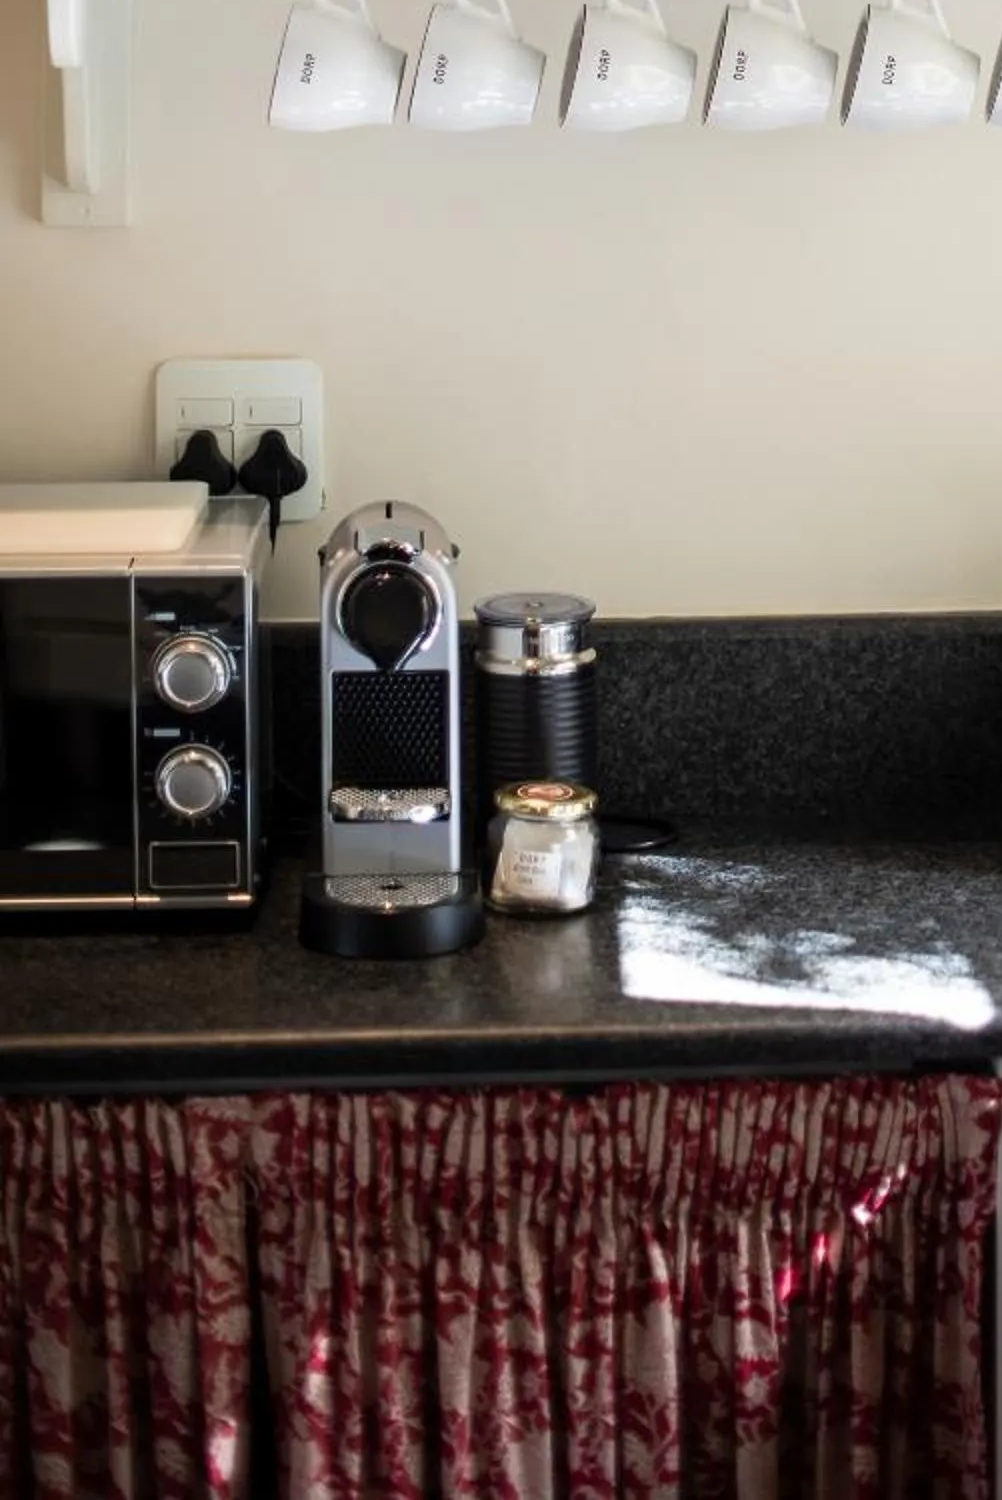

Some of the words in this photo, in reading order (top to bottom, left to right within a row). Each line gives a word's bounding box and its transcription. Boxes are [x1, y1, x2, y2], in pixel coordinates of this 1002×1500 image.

[300, 53, 315, 84] DORP
[597, 49, 610, 81] DORP
[881, 56, 896, 84] DORP
